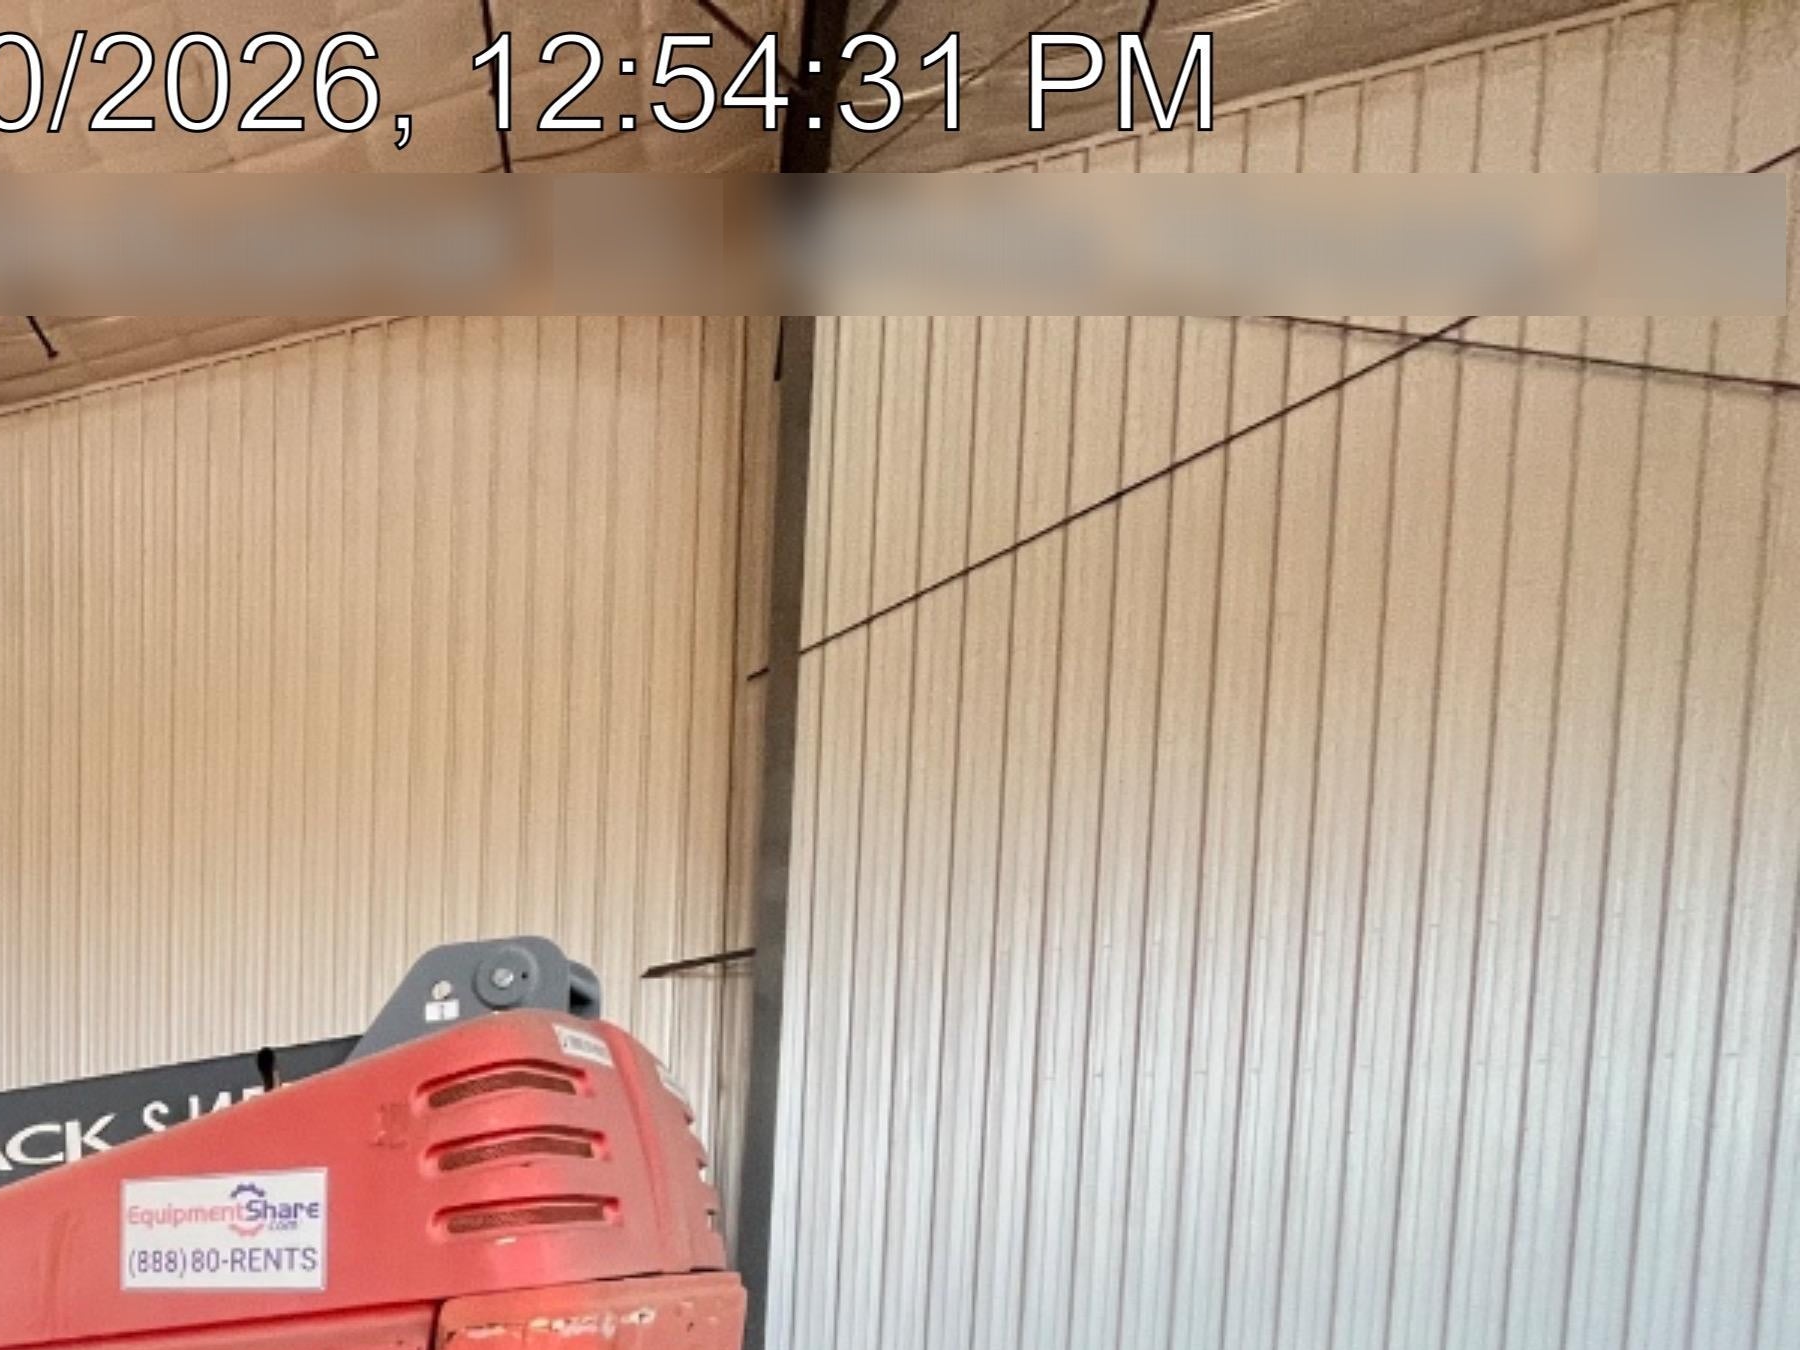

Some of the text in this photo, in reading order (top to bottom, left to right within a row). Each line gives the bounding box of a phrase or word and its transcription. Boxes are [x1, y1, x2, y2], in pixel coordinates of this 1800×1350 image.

[128, 1200, 319, 1228] EquipmentShare
[128, 1247, 317, 1278] (888) 80-RENTS
